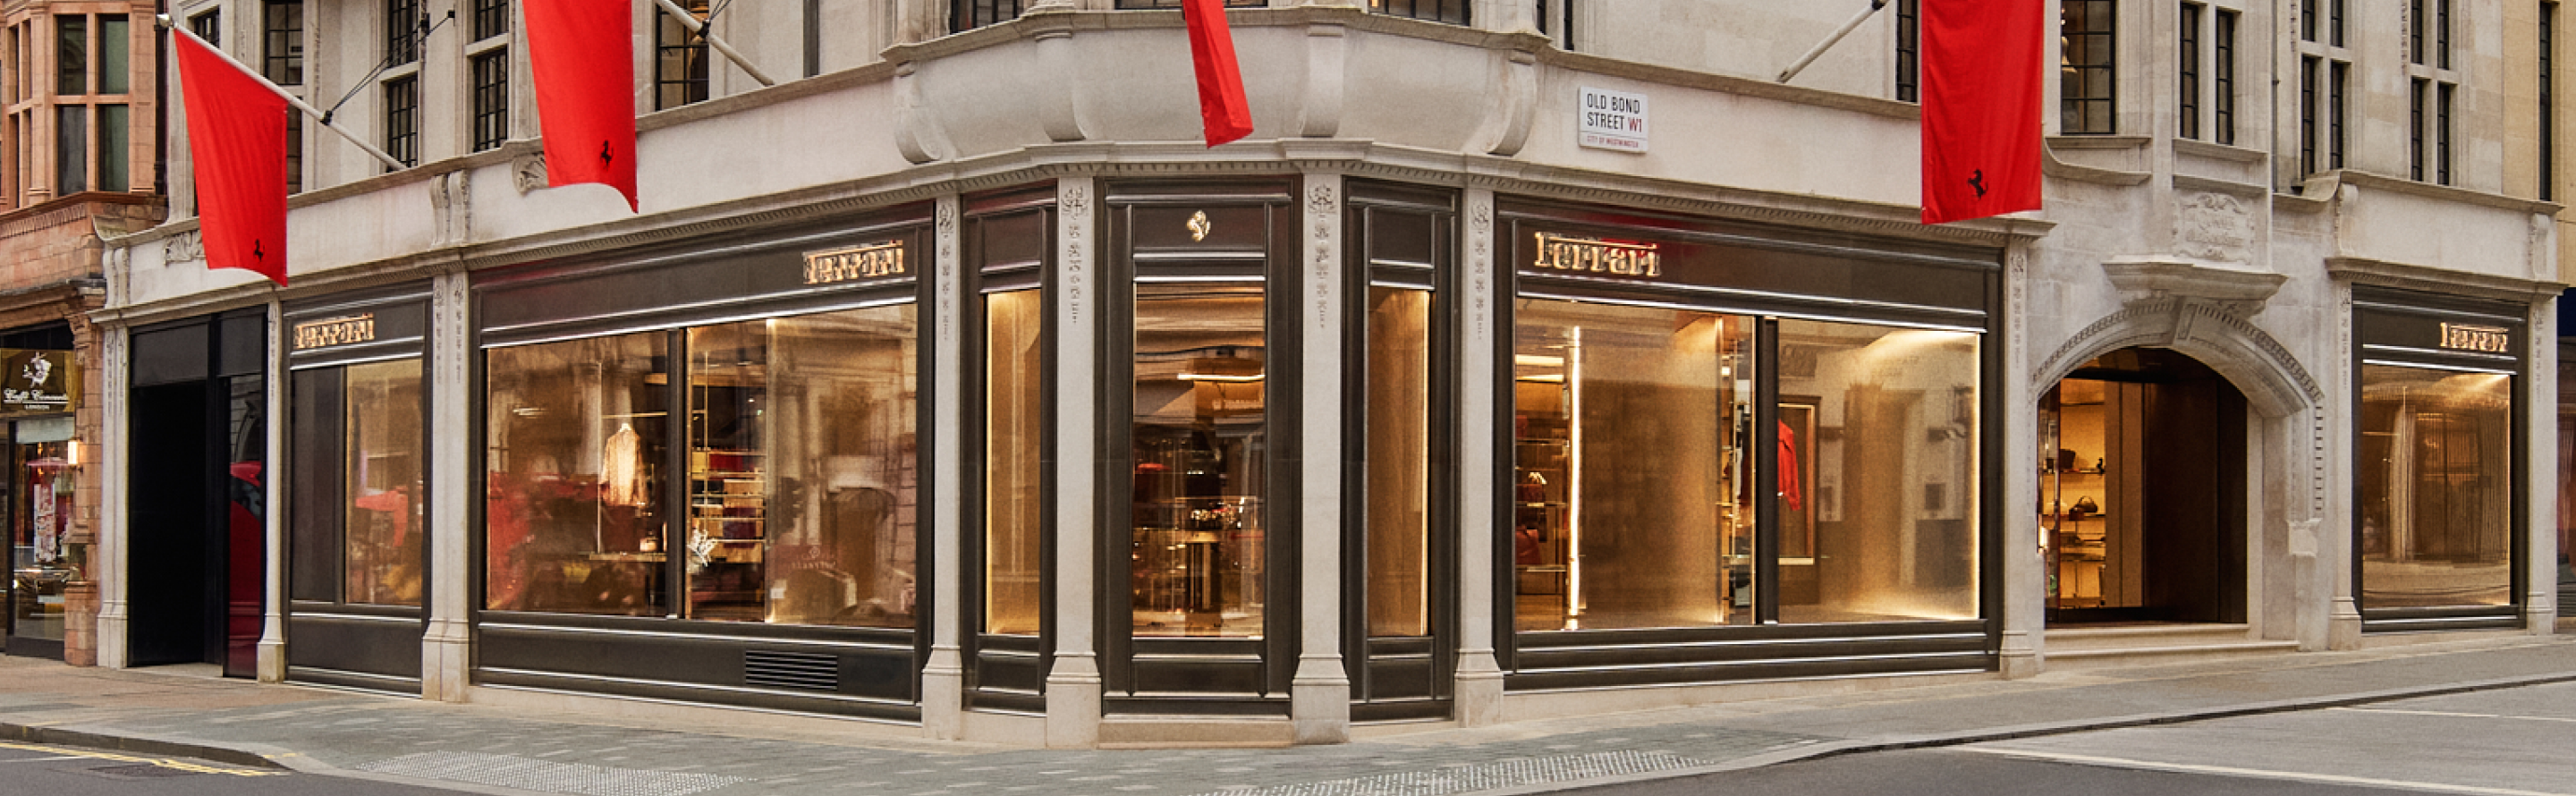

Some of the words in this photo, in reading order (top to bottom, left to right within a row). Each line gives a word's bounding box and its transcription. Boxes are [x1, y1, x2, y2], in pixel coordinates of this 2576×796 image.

[1587, 93, 1606, 109] OLD
[1612, 96, 1640, 114] BOND
[1587, 112, 1624, 131] STREET
[1628, 116, 1642, 132] W1
[803, 240, 904, 284] Ferrari
[1534, 231, 1661, 277] Ferrari
[293, 312, 375, 349] Ferrari
[2440, 322, 2509, 352] Ferrari
